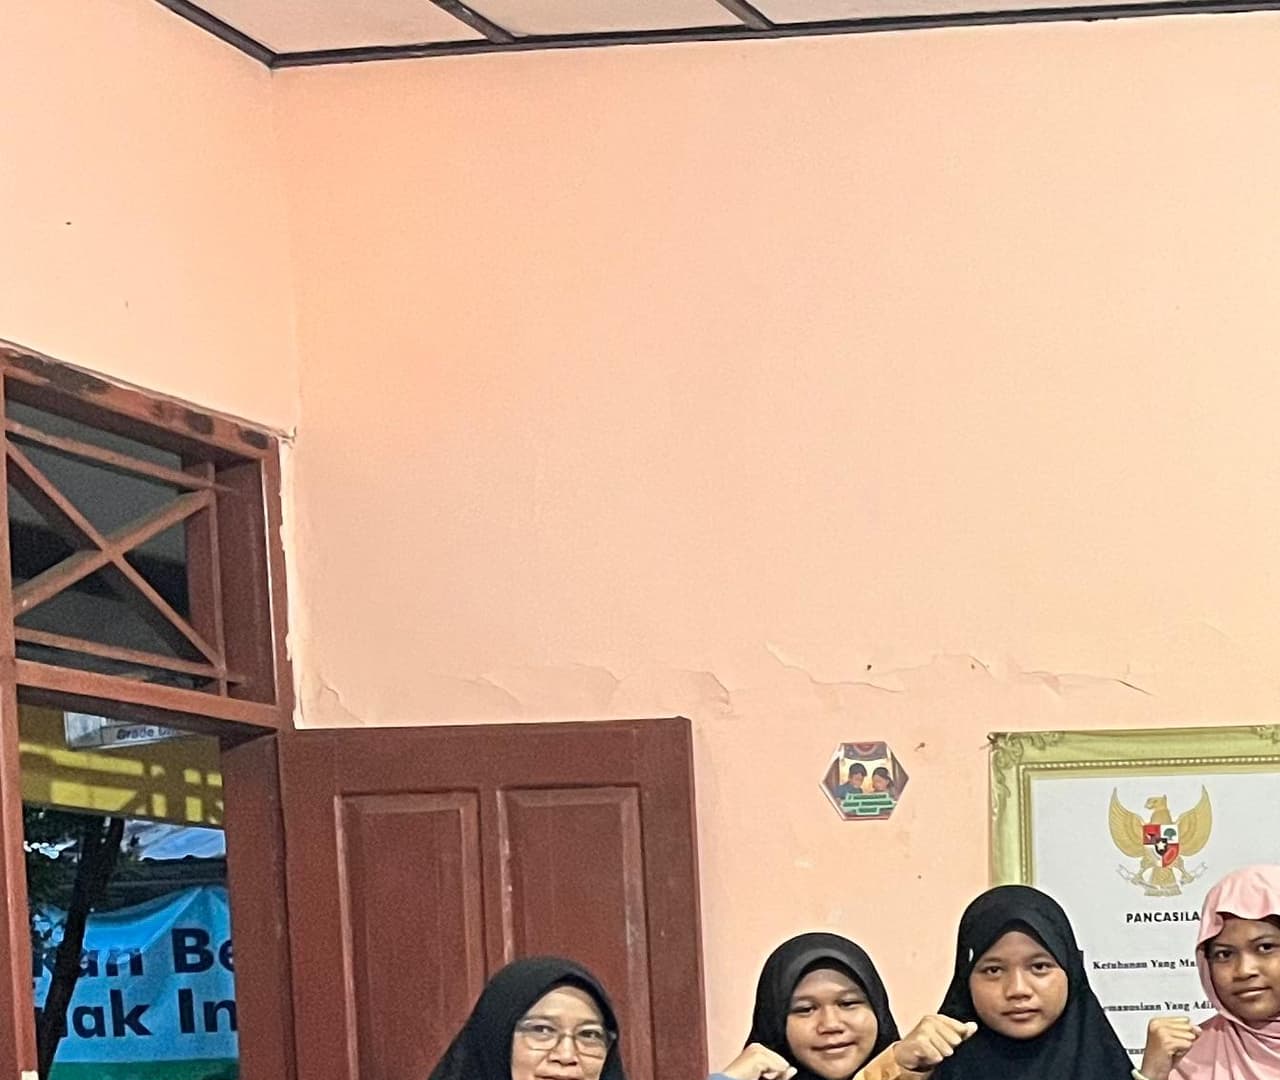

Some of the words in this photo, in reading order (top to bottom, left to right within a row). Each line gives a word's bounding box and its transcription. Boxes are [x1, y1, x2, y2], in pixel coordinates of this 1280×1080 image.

[1126, 910, 1201, 923] PANCASILA
[1151, 959, 1176, 969] Yang
[1164, 1000, 1190, 1012] Yang
